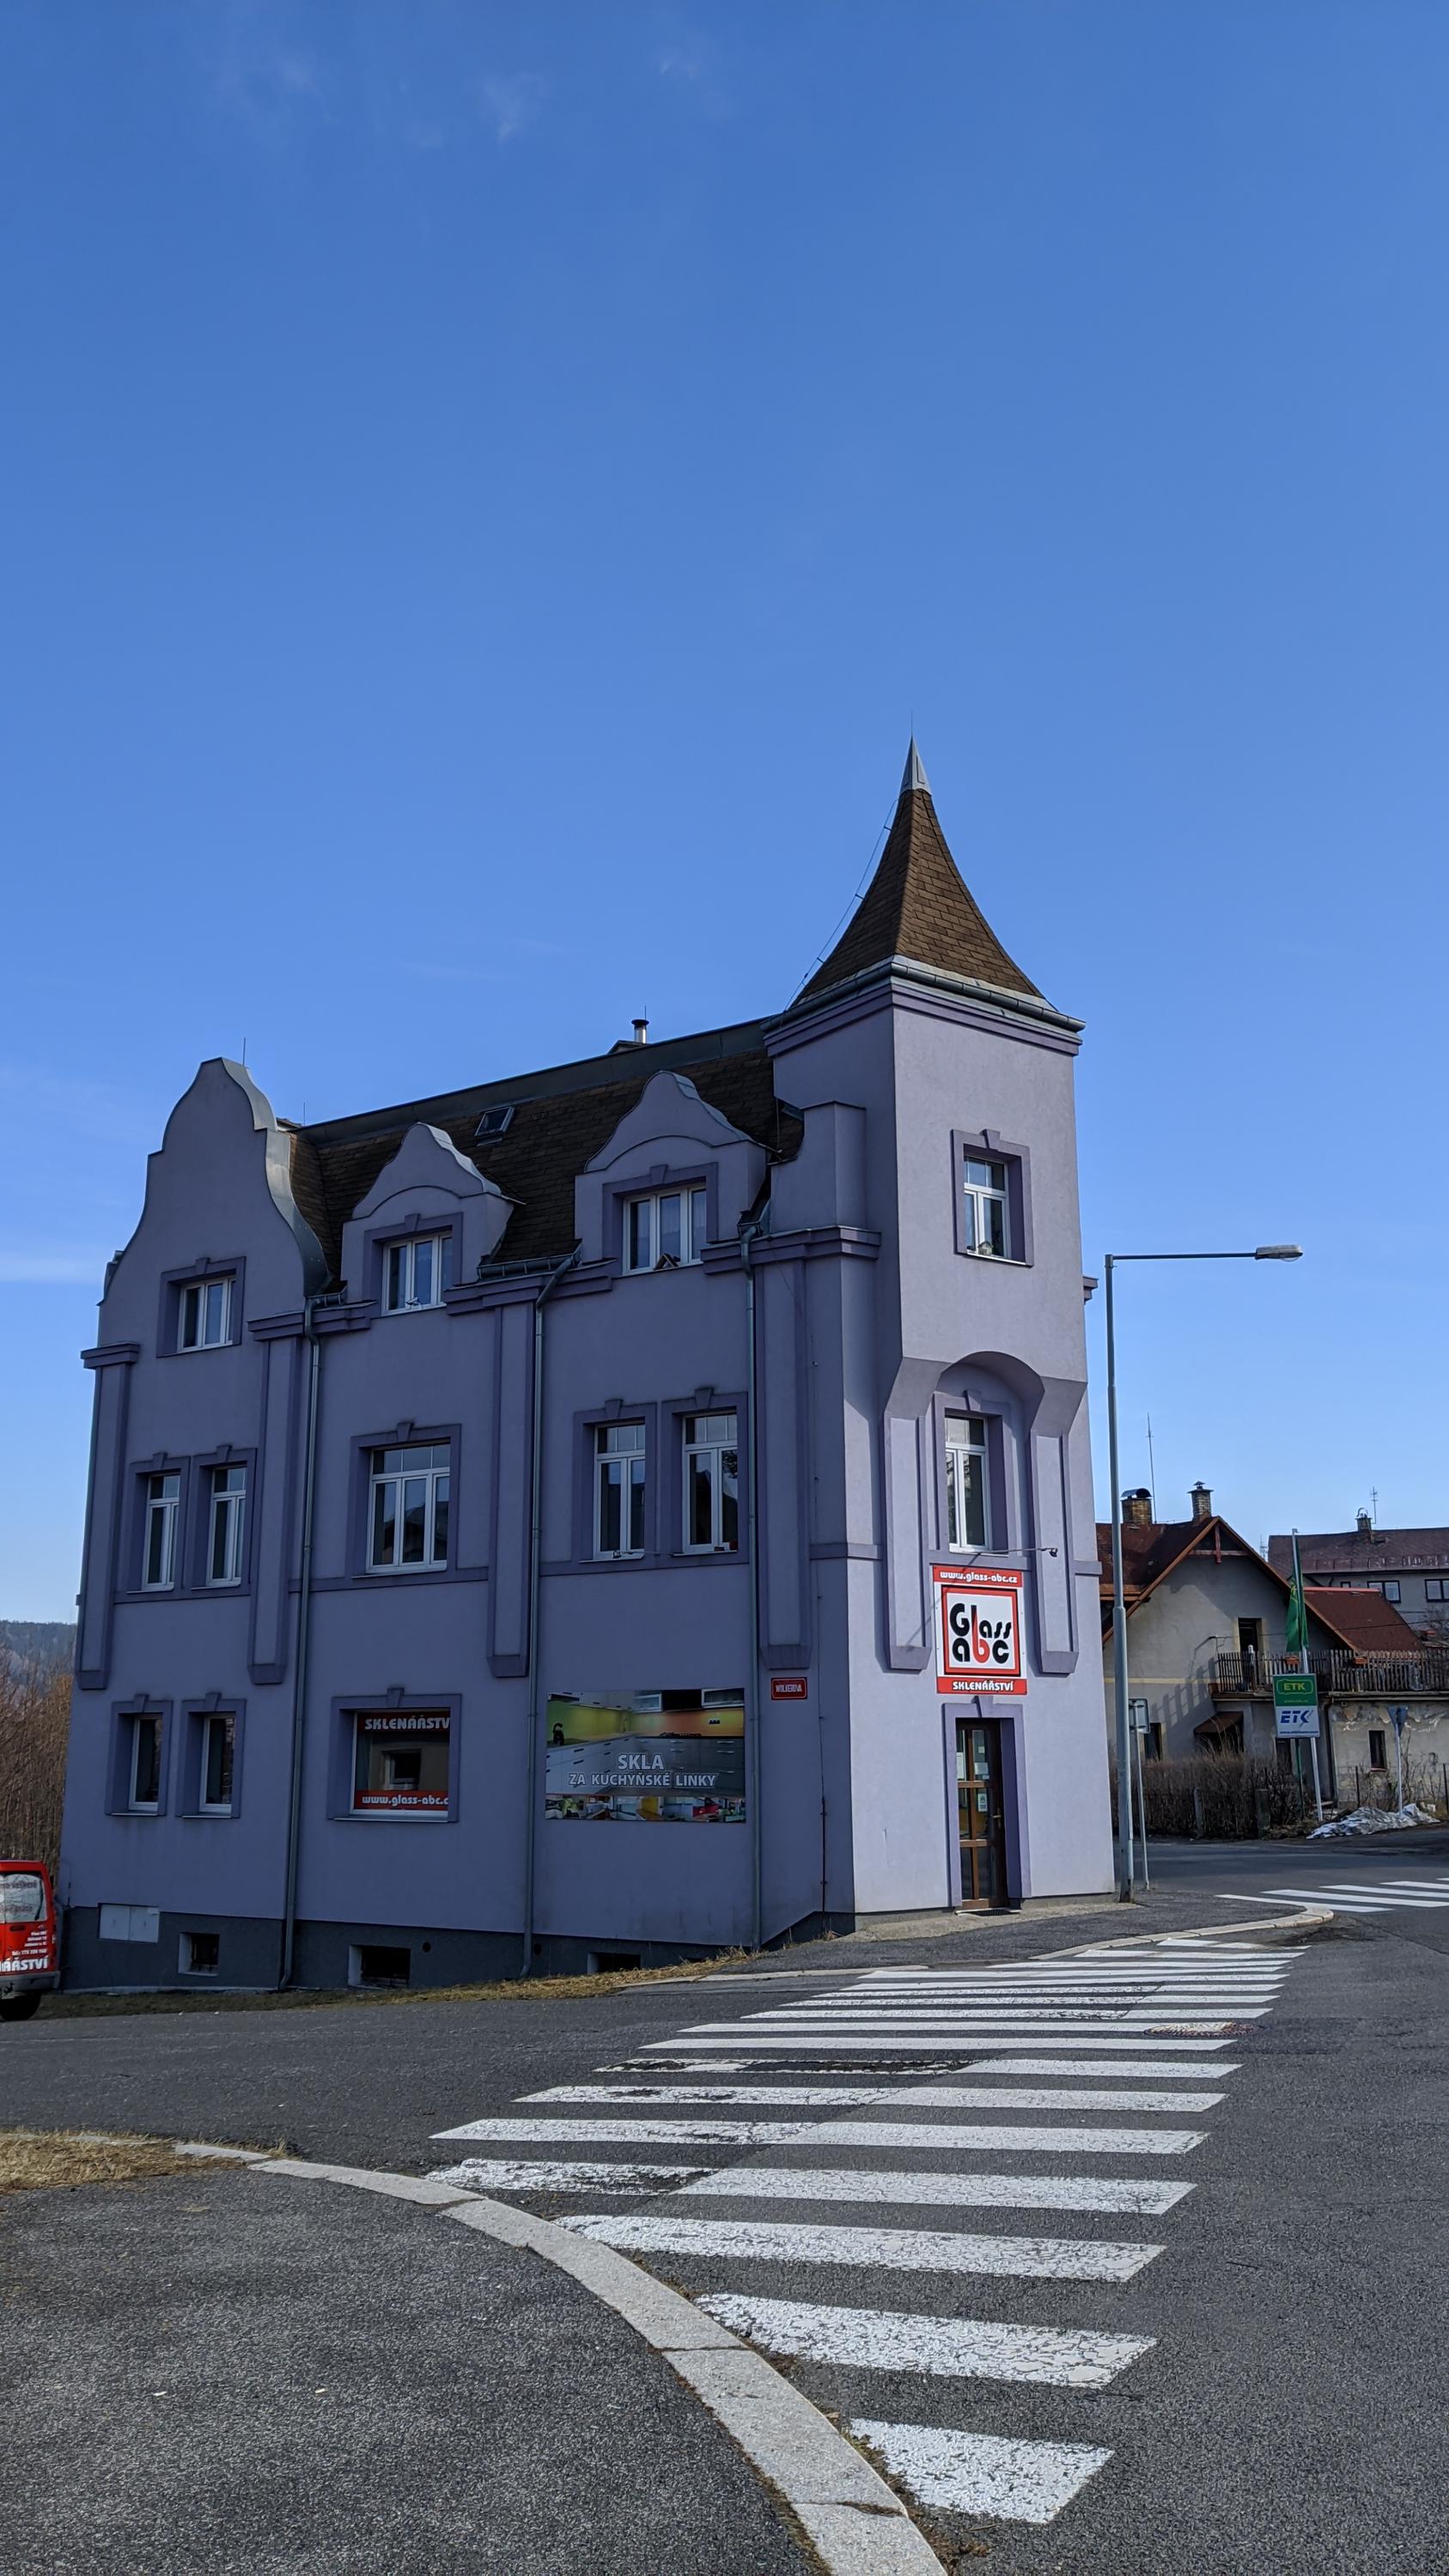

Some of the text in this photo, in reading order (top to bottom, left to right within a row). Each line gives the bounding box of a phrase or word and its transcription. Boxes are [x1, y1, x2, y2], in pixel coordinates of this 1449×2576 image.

[940, 1571, 1018, 1583] www.glass-abc.cz
[949, 1602, 1012, 1639] Glass
[952, 1636, 1010, 1664] abc
[952, 1680, 1014, 1692] SKLENÁŘSTVÍ
[1283, 1682, 1306, 1691] ETK
[1280, 1710, 1311, 1724] ETK
[618, 1754, 664, 1771] SKLA
[569, 1771, 716, 1787] ZA KUCHYŇSKÉ LINKY
[0, 1954, 49, 1972] ÁŘSTVÍ
